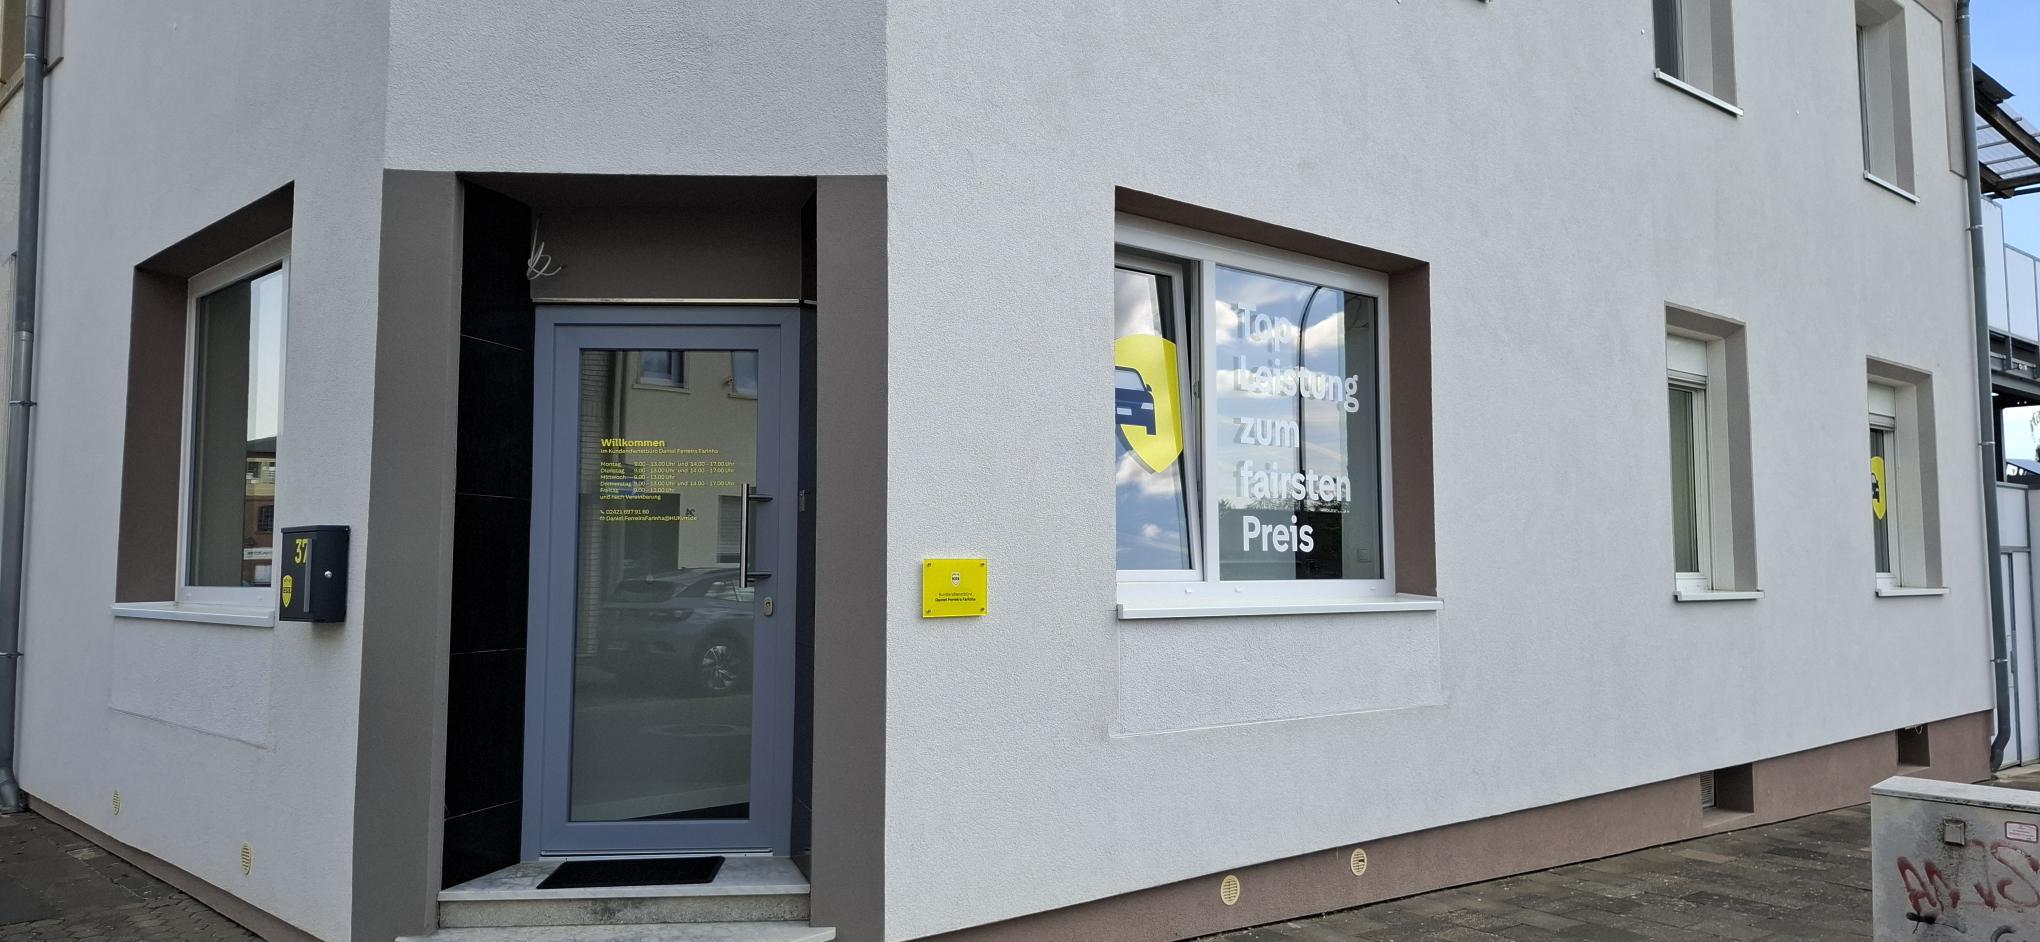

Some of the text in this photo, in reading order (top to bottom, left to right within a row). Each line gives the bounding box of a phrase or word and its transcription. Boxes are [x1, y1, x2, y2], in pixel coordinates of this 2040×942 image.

[1237, 303, 1292, 352] Top
[1238, 355, 1360, 413] Leistung
[600, 438, 666, 447] Willkommen
[1240, 417, 1300, 448] zum
[1240, 460, 1351, 501] fairsten
[294, 538, 309, 564] 37
[1242, 515, 1315, 553] Preis
